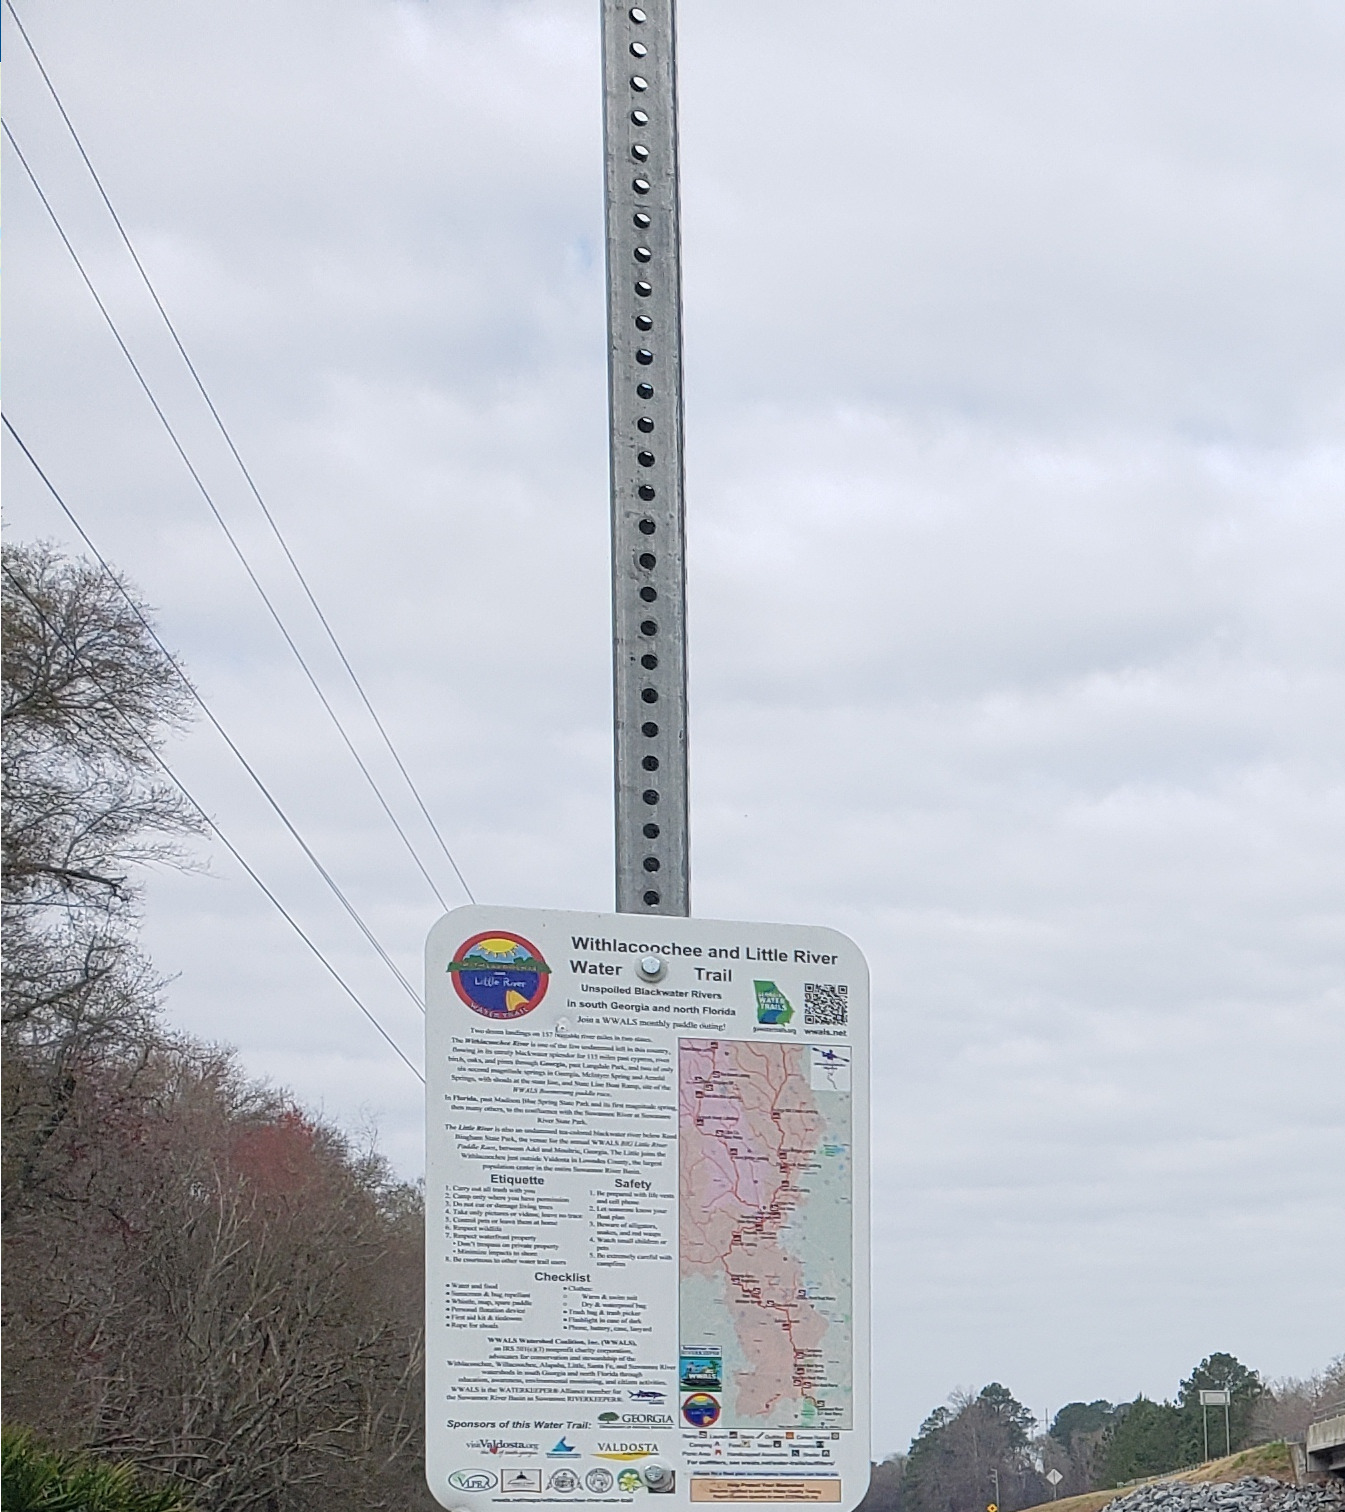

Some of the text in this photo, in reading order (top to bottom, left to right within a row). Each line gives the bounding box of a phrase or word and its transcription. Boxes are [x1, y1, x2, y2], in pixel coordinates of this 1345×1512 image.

[572, 936, 838, 965] Withlacoochee and Little River
[570, 960, 732, 982] Water Trail
[581, 984, 722, 999] Unspoiled Blackwater Rivers
[580, 1001, 608, 1009] south
[611, 1002, 650, 1013] Georgia
[652, 1005, 670, 1013] and
[673, 1005, 699, 1014] north
[703, 1006, 736, 1016] Florida
[577, 1016, 591, 1024] Join
[602, 1017, 637, 1026] WWALS
[640, 1018, 670, 1029] monthly
[804, 1029, 847, 1037] wwals.net
[490, 1174, 545, 1185] Etiquette
[615, 1179, 652, 1190] Safety
[534, 1272, 590, 1282] Checklist
[622, 1414, 674, 1423] GEORGIA
[447, 1420, 496, 1430] Sponsors
[500, 1420, 510, 1429] of
[512, 1421, 530, 1429] this
[534, 1421, 564, 1429] Water
[567, 1421, 592, 1430] Trail:
[598, 1443, 659, 1452] VALDOSTA
